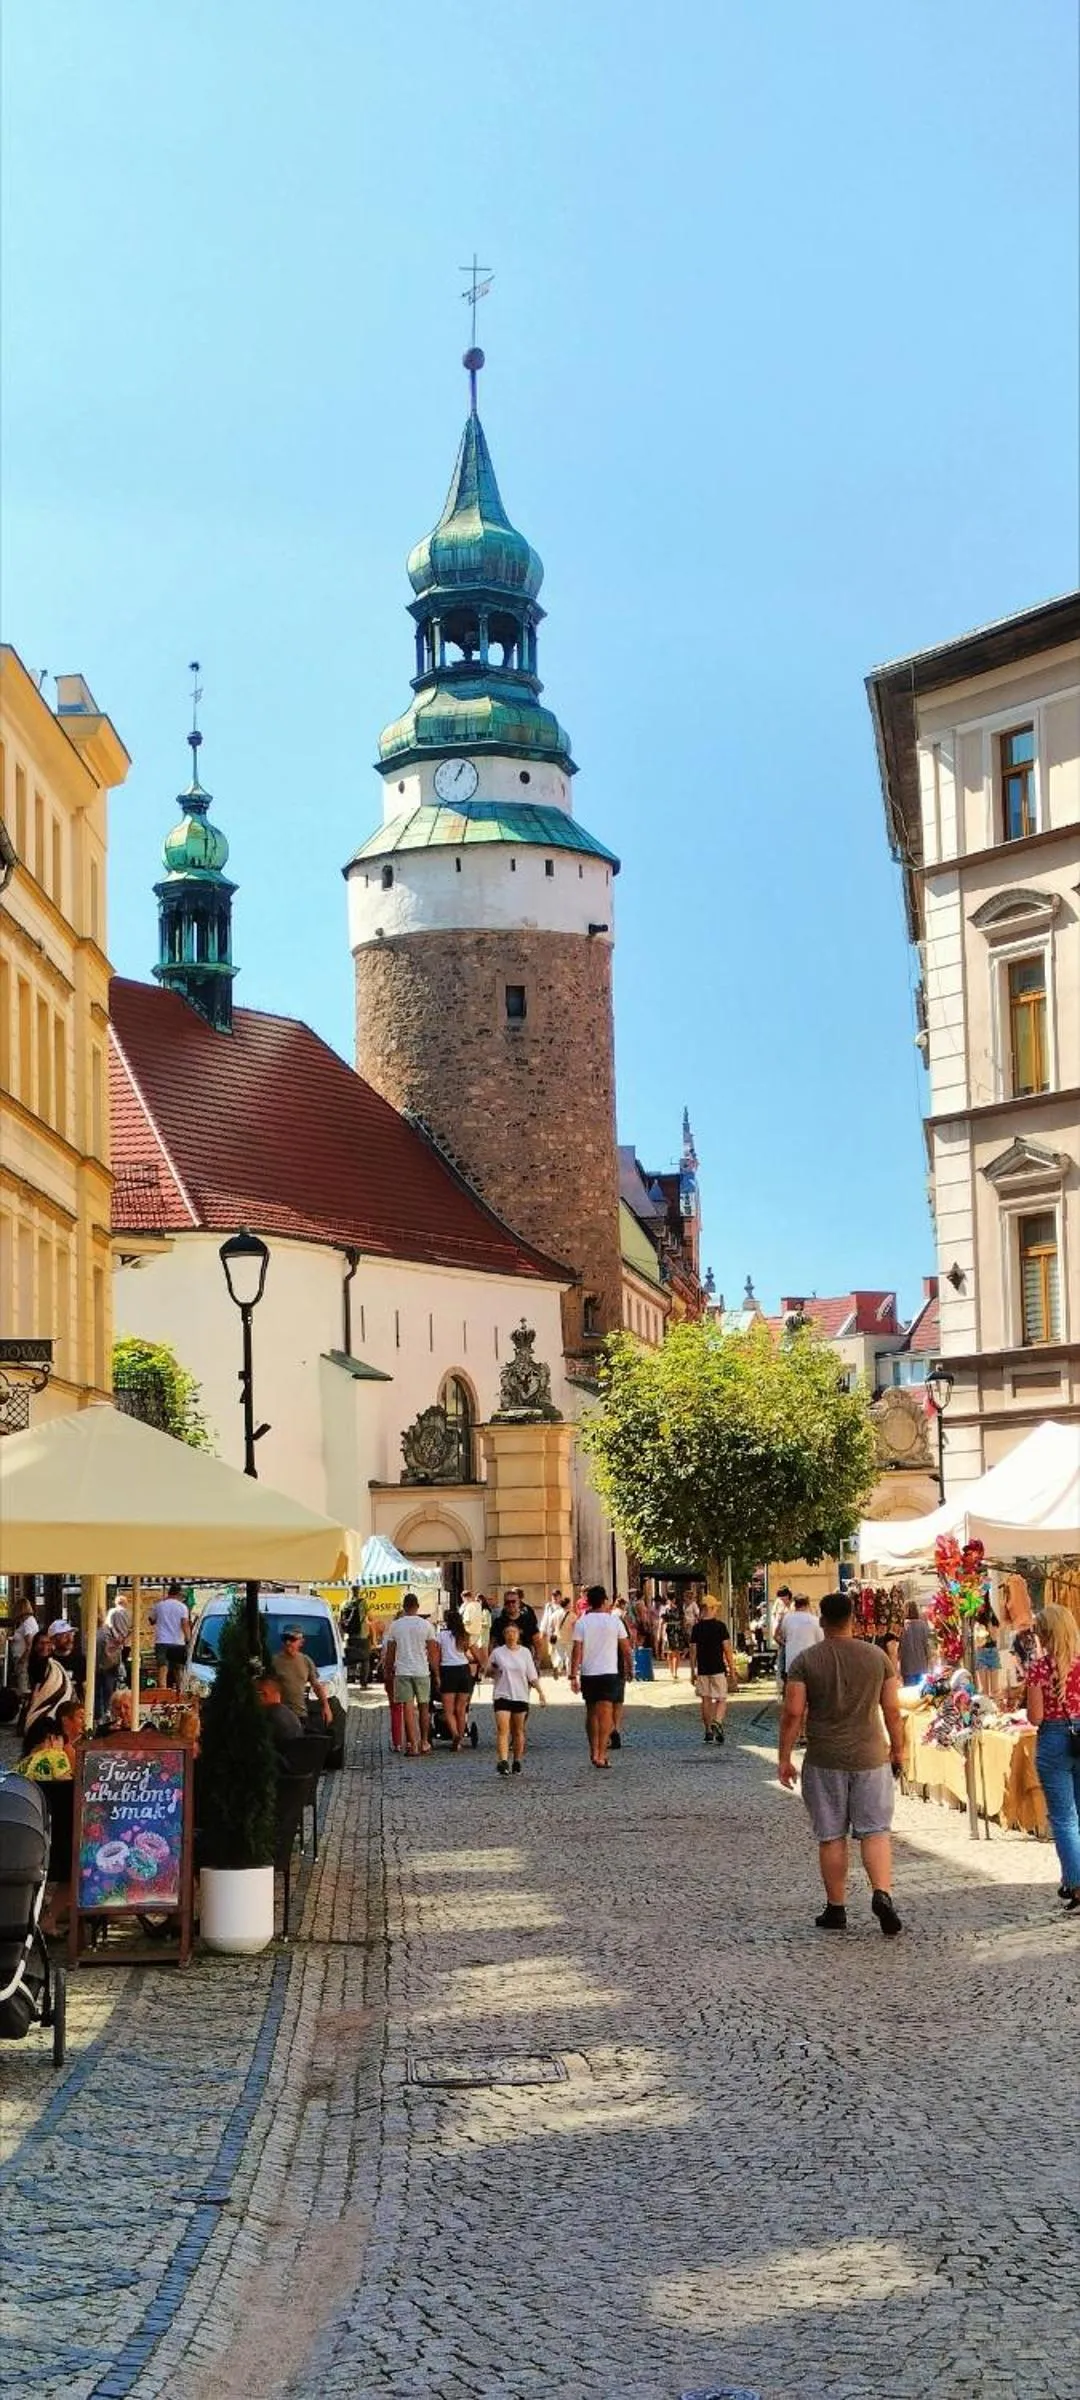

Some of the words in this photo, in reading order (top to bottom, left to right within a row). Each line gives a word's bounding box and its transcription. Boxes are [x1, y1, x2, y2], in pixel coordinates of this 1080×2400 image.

[98, 1759, 154, 1790] Twój
[85, 1782, 182, 1813] ulubiony
[110, 1803, 166, 1820] smak
